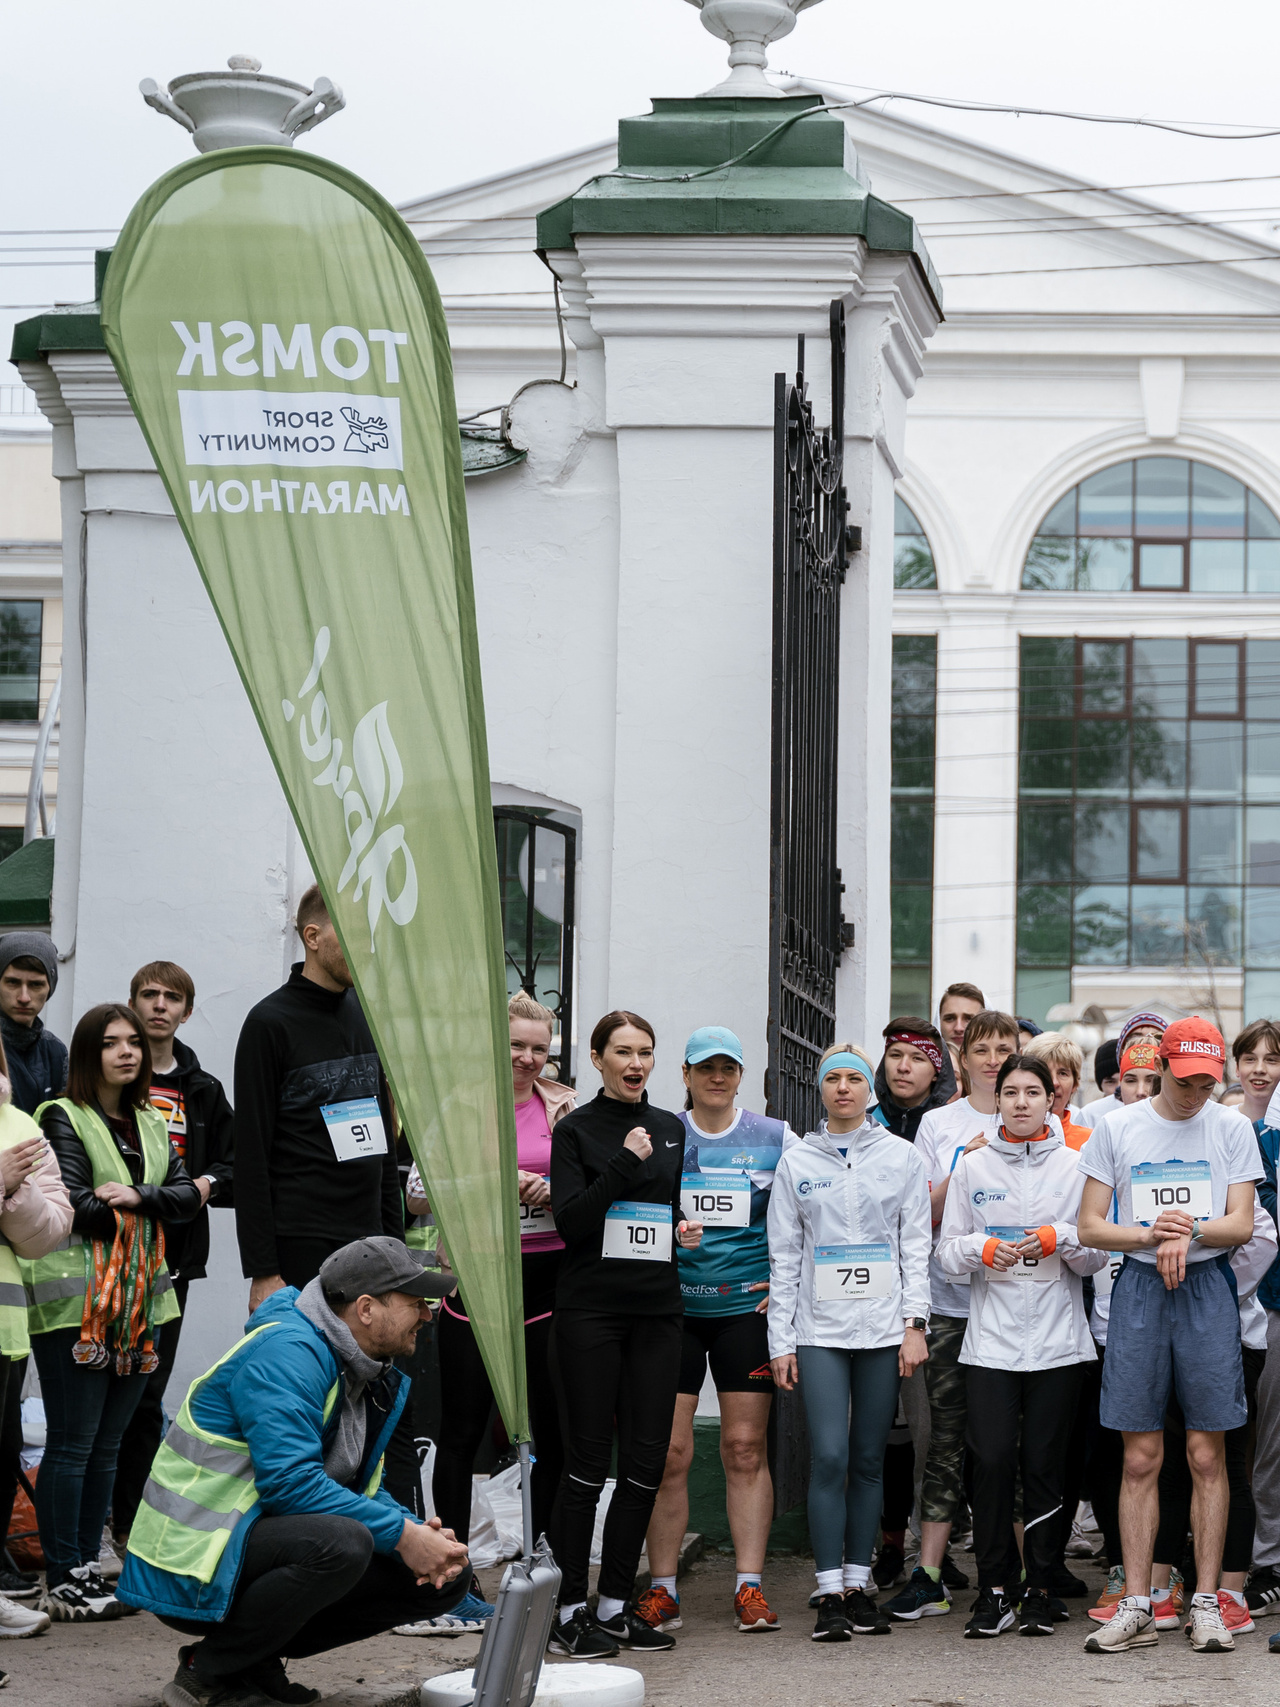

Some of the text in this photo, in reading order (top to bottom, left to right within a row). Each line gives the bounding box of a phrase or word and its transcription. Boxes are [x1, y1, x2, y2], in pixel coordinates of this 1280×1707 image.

[1180, 1041, 1221, 1057] RUSSIA
[351, 1123, 371, 1143] 91
[731, 1157, 747, 1165] SRF
[692, 1195, 733, 1212] 105
[1151, 1187, 1191, 1206] 100
[627, 1226, 656, 1245] 101
[837, 1267, 870, 1286] 79
